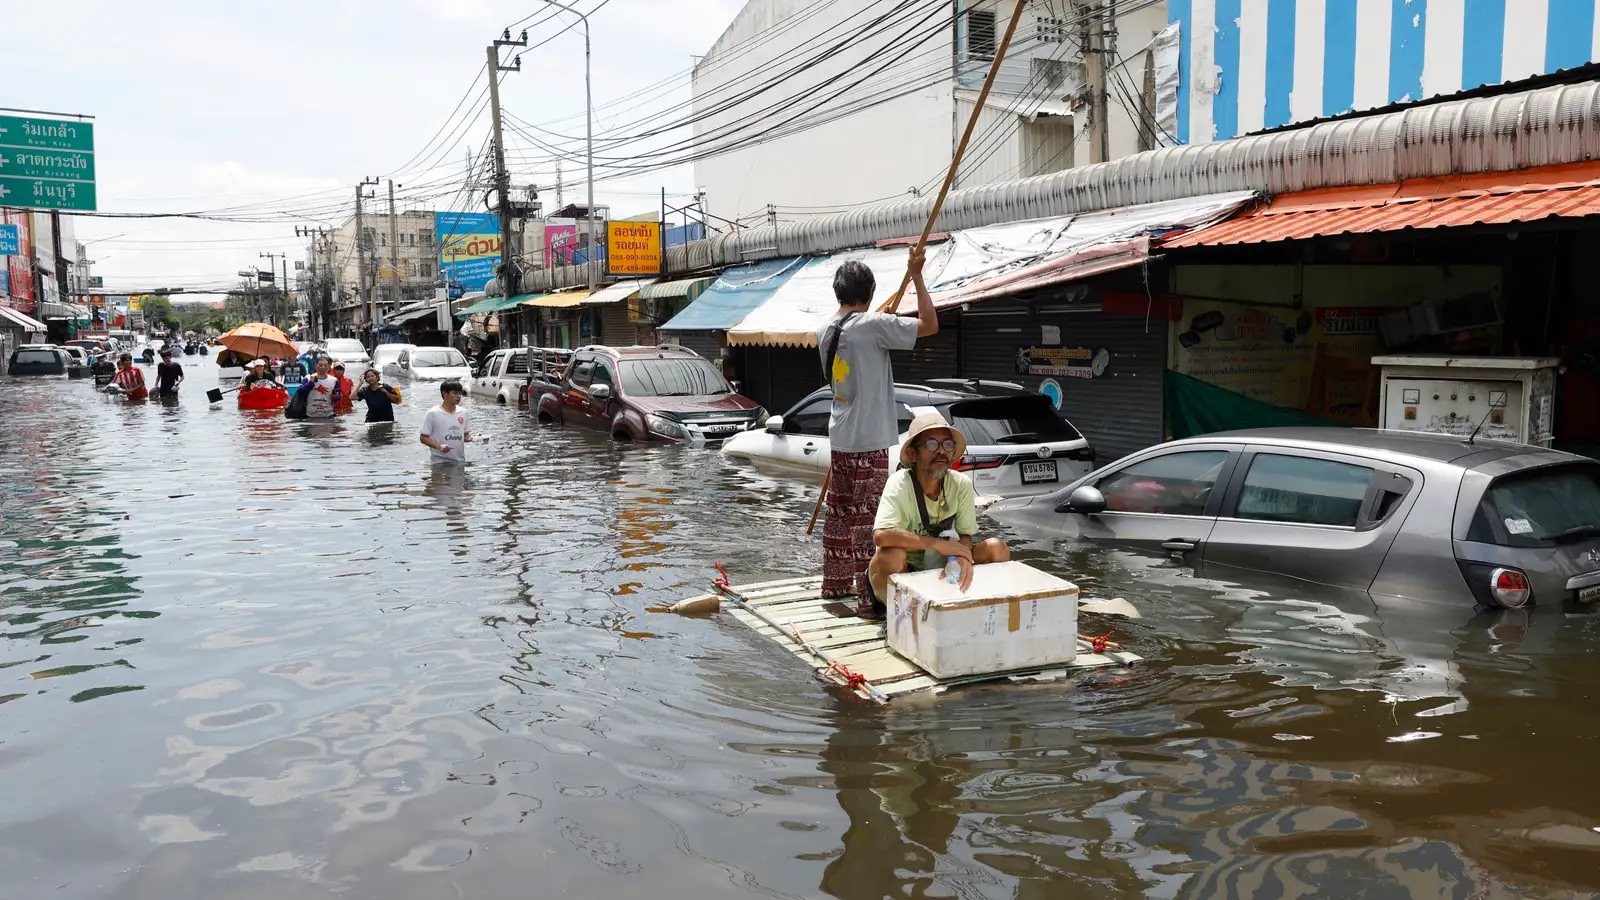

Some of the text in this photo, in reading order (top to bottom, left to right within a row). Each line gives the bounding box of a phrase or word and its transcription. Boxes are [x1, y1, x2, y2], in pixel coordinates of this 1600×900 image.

[22, 121, 76, 138] ร่มเกล้า
[16, 153, 87, 169] ลาดกระบัง
[45, 170, 80, 179] Krabang
[33, 181, 76, 201] มีนบุรี
[614, 224, 652, 237] สอนขับ
[466, 236, 502, 256] ด่วน
[615, 237, 650, 250] รถยนต์
[1038, 462, 1055, 473] 8785
